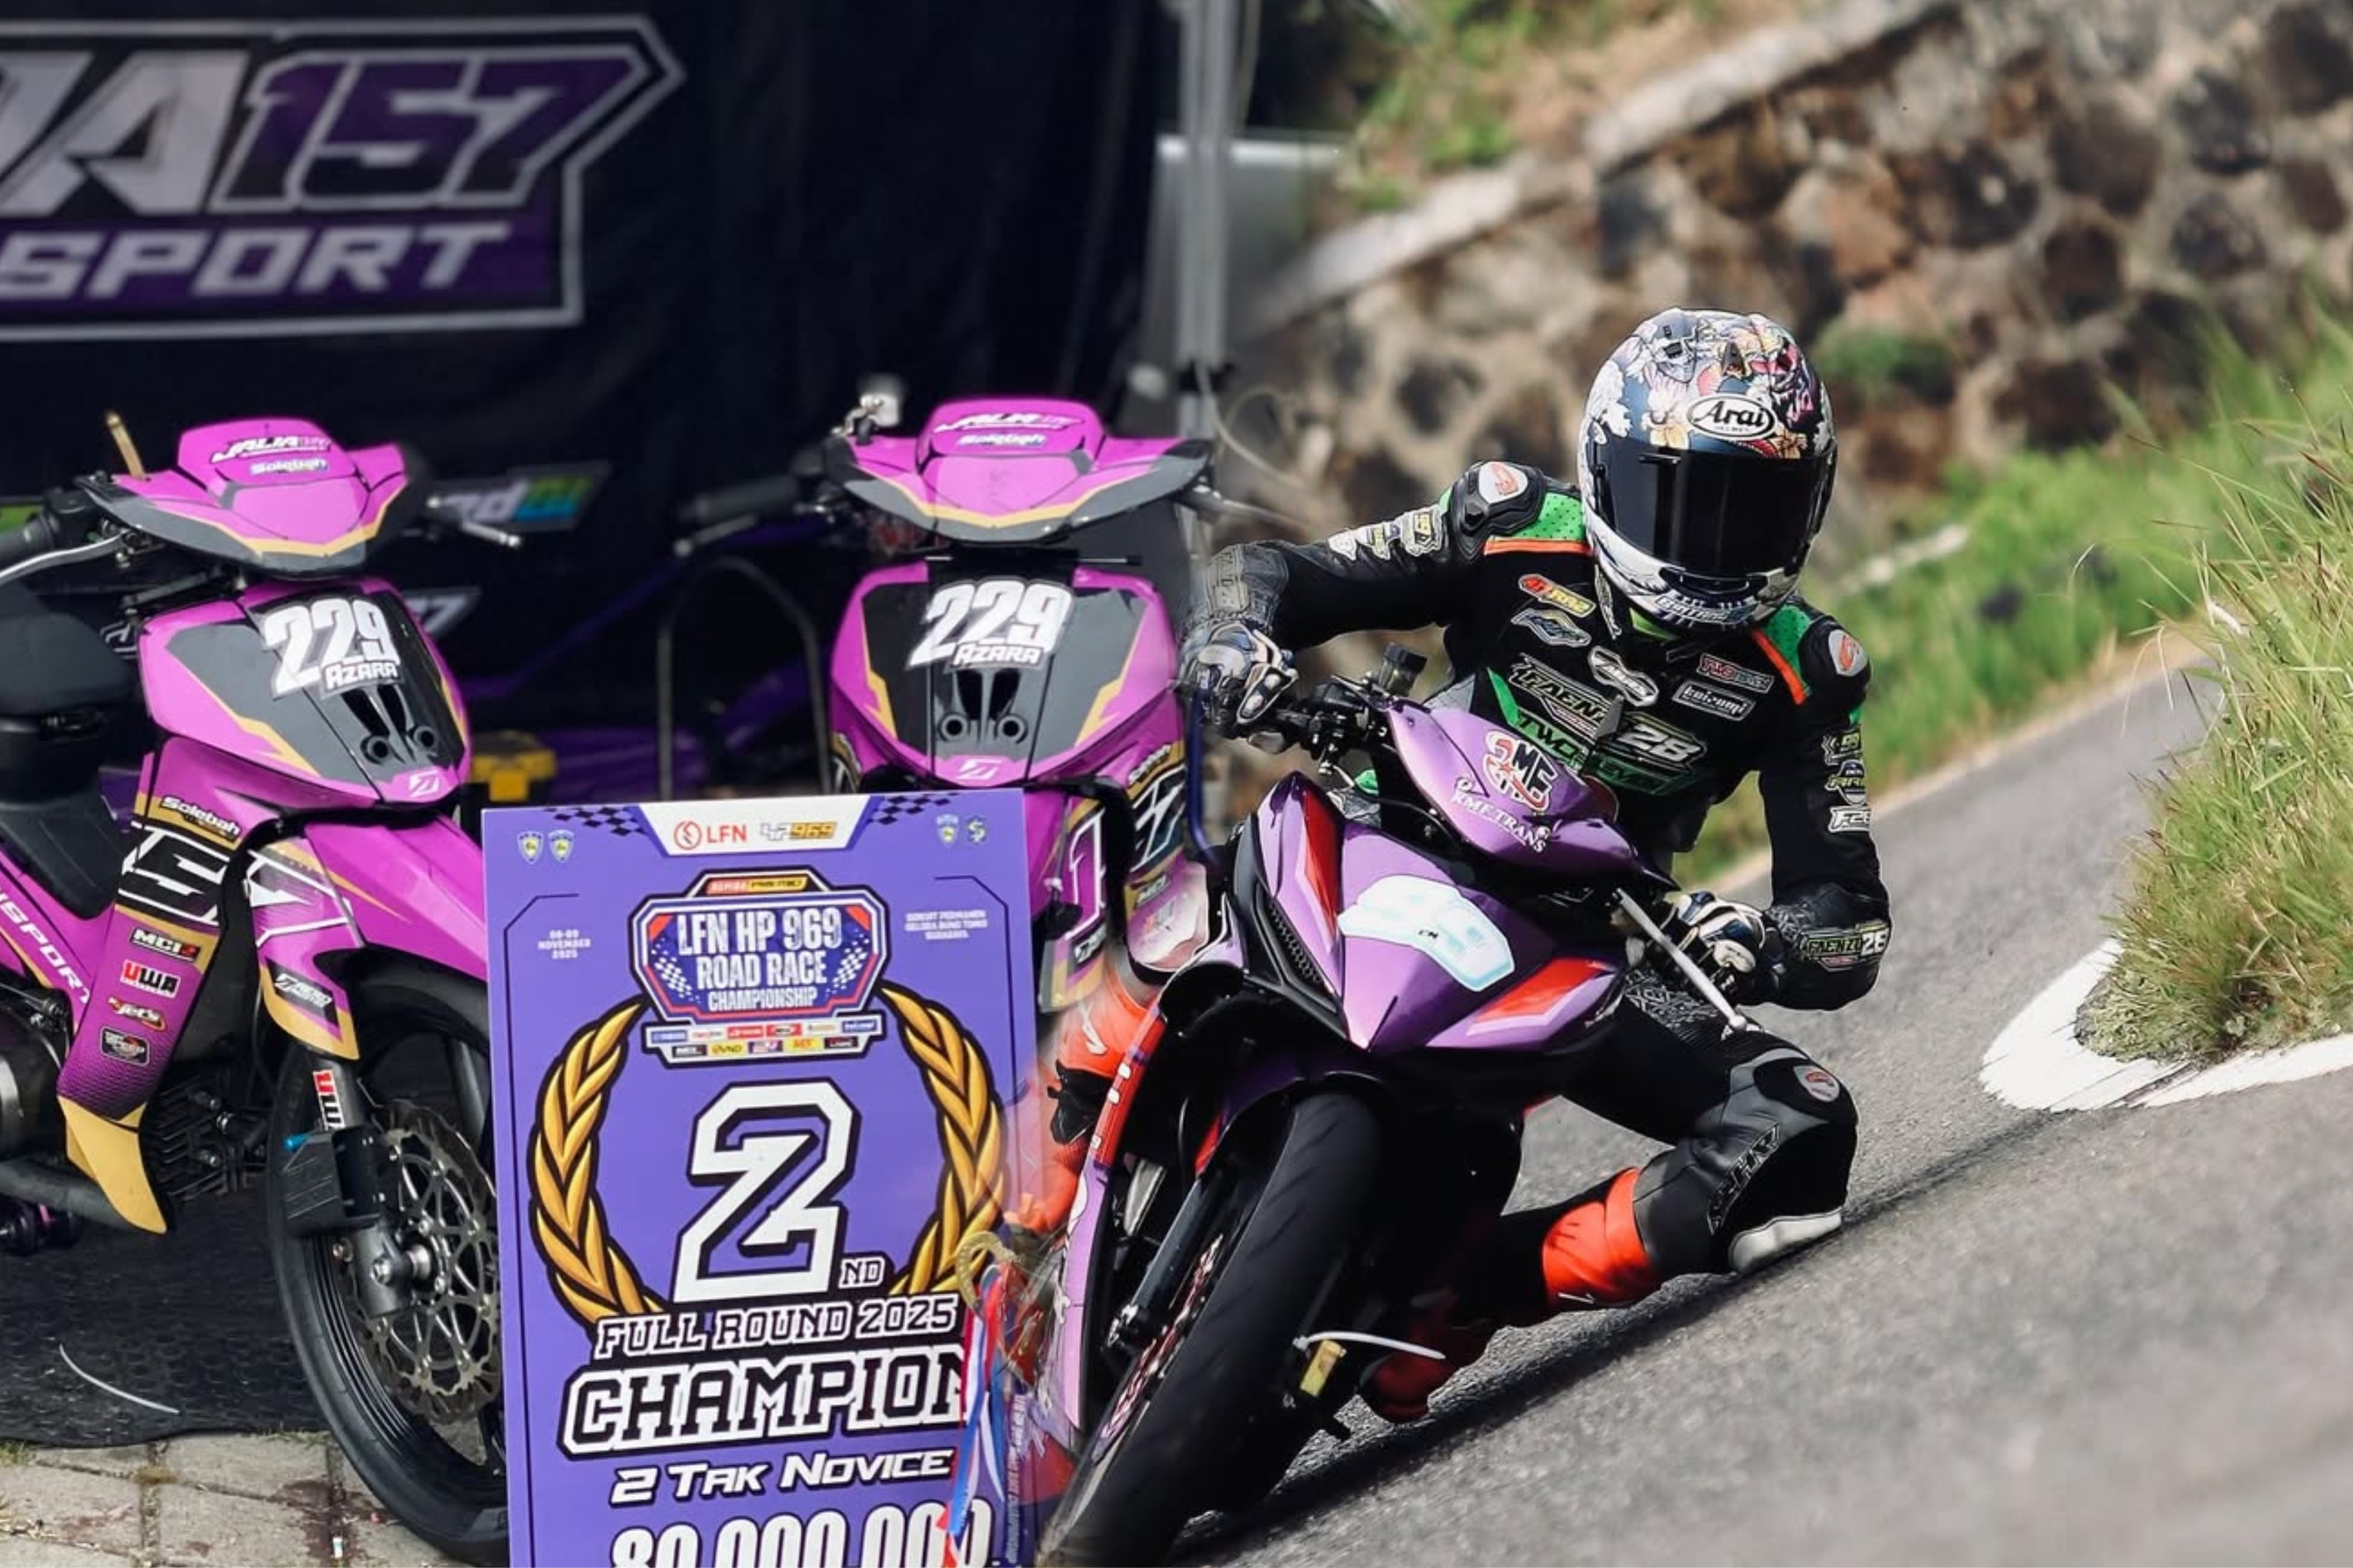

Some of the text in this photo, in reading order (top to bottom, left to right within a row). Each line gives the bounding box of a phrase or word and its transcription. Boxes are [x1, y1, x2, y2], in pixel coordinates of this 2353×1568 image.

[1694, 400, 1765, 427] Arai
[910, 580, 1073, 667] 229
[263, 598, 400, 692] 229
[954, 644, 1043, 665] AZARA
[325, 663, 399, 690] AZARA
[707, 824, 747, 843] LFN
[677, 907, 842, 955] LFN HP 969
[696, 950, 827, 990] ROAD RACE
[708, 986, 817, 1011] CHAMPIONSHIP
[839, 1257, 886, 1288] ND
[595, 1293, 959, 1360] FULL ROUND 2025
[611, 1449, 956, 1504] 2 TAK NOVICE
